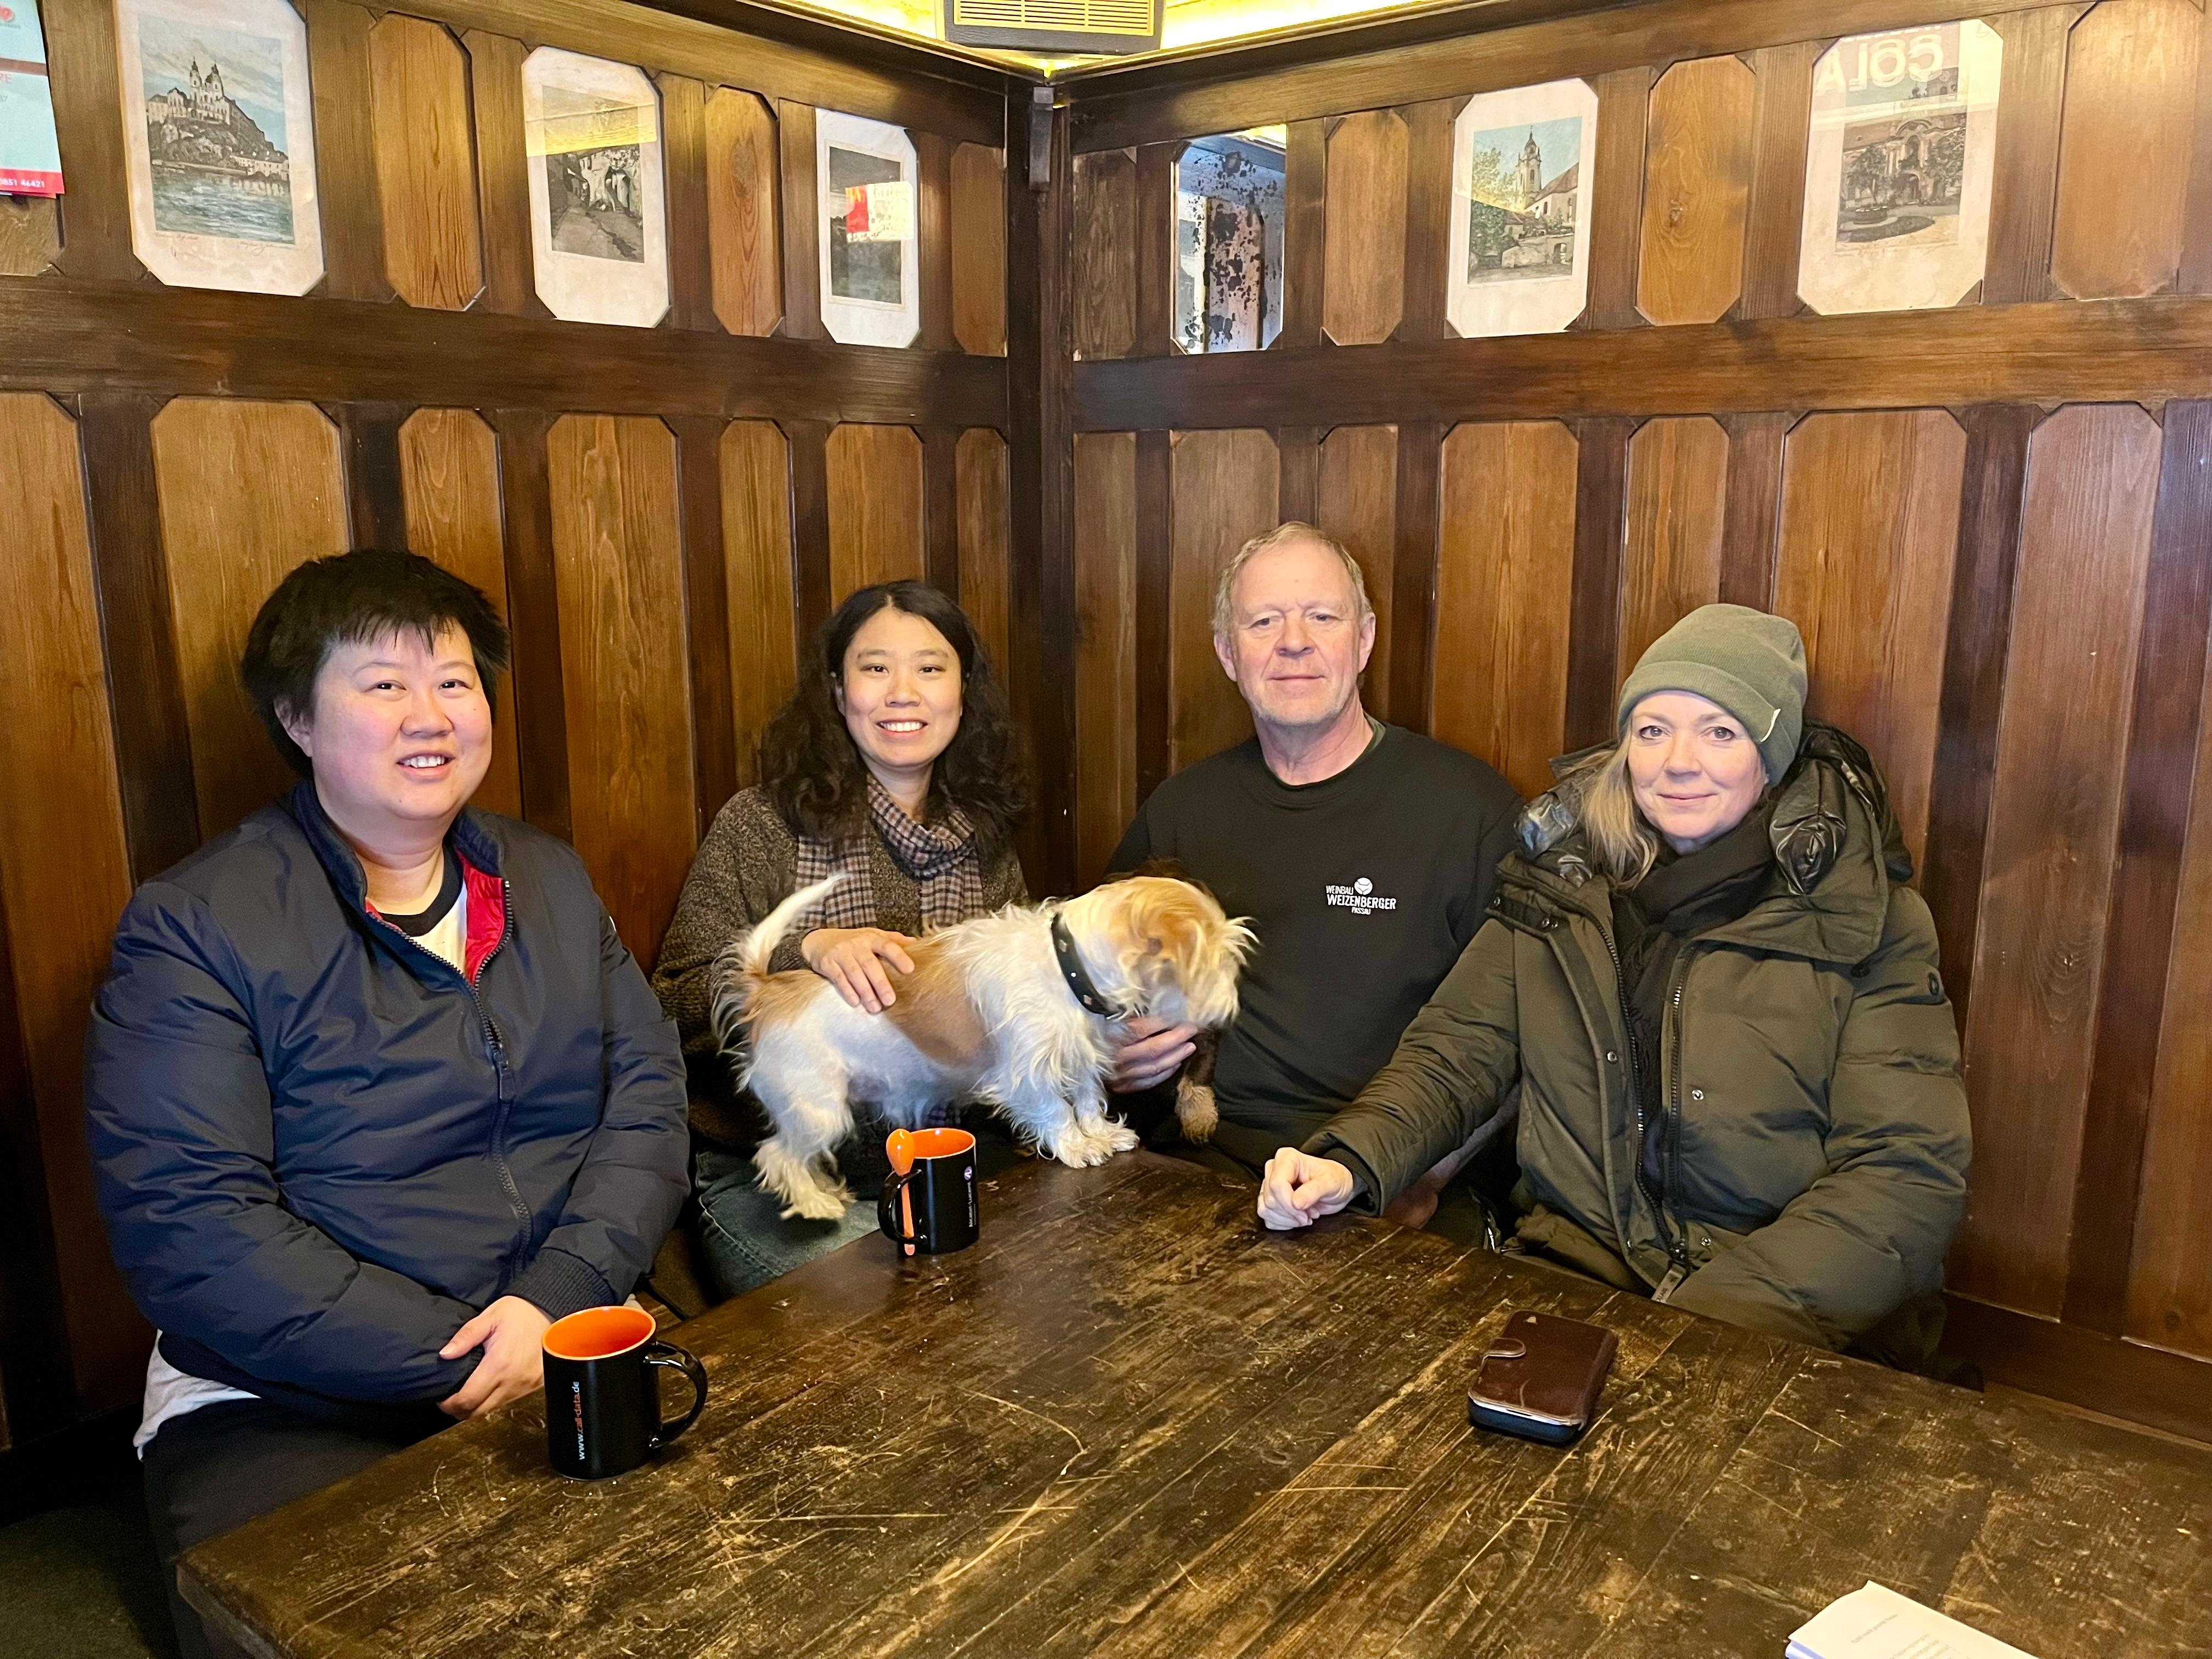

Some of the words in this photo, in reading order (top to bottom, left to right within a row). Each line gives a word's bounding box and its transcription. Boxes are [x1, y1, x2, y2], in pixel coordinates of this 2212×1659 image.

[21, 179, 45, 188] 46421
[1326, 885, 1353, 895] WEINBAU
[1327, 894, 1397, 910] WEIZENBERGER
[571, 1381, 585, 1460] www.call-data.de
